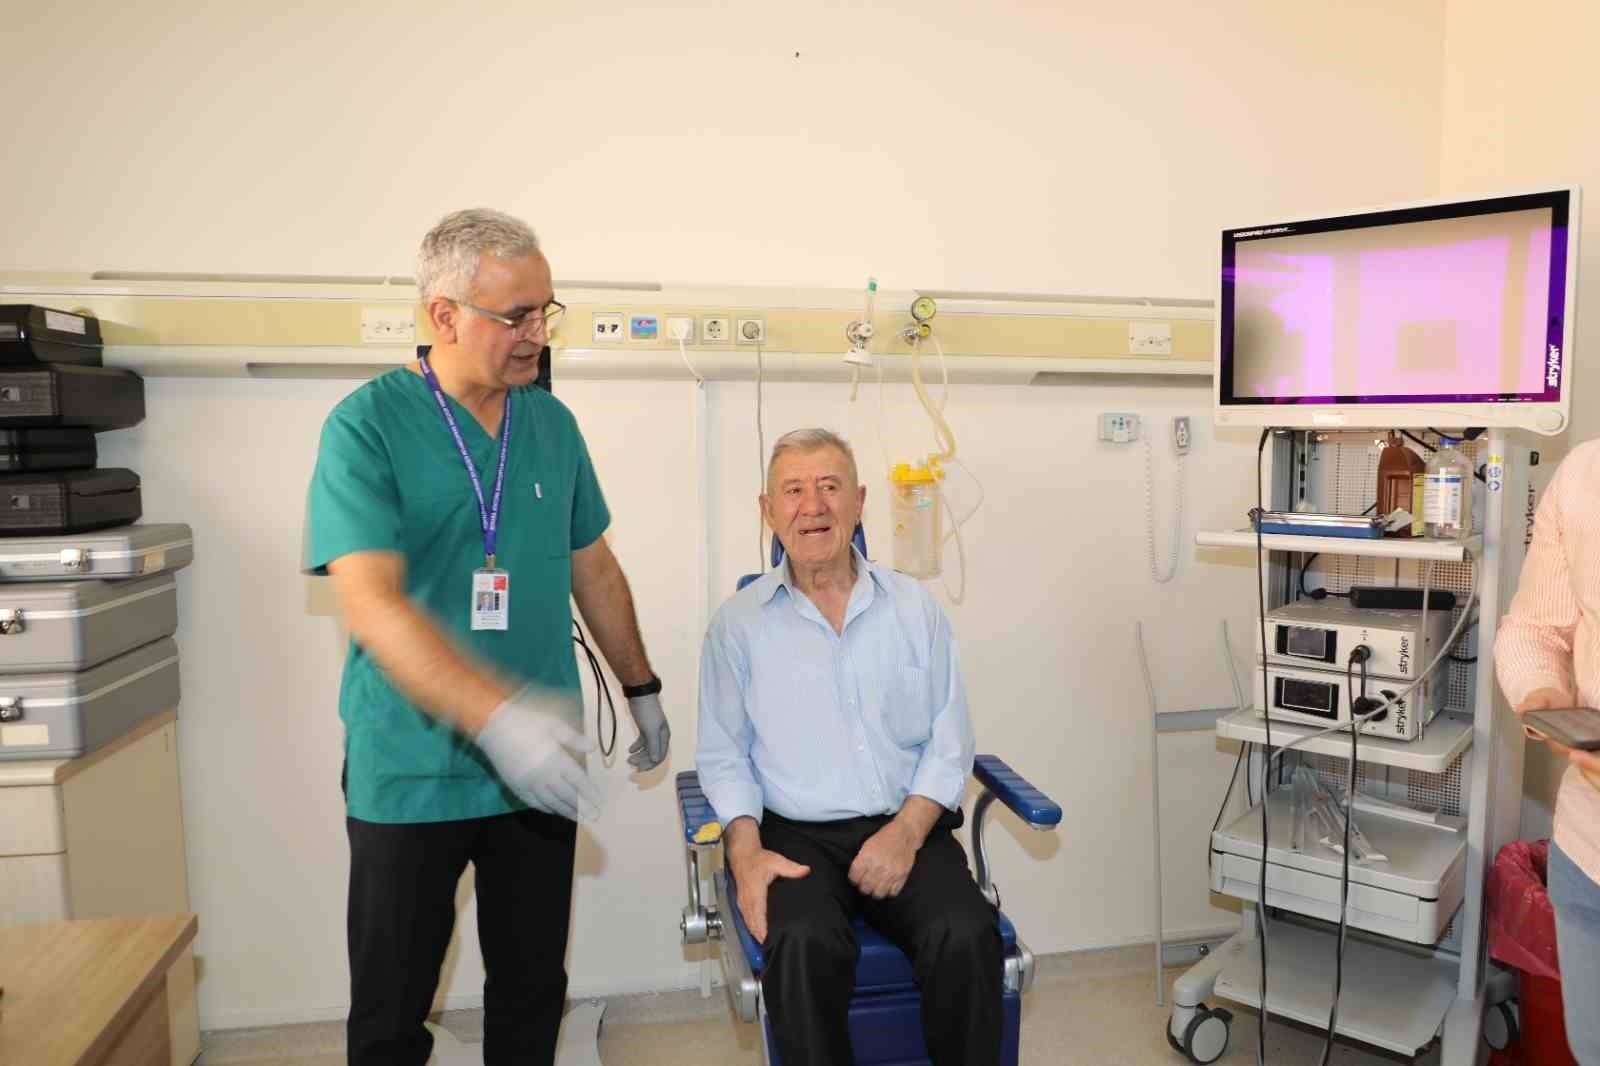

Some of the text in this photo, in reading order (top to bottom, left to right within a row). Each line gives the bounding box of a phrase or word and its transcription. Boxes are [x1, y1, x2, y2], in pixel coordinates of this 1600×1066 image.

[1546, 344, 1560, 387] stryker
[1524, 482, 1535, 554] tryker
[1398, 636, 1409, 674] stryker
[1396, 700, 1407, 735] stryke
